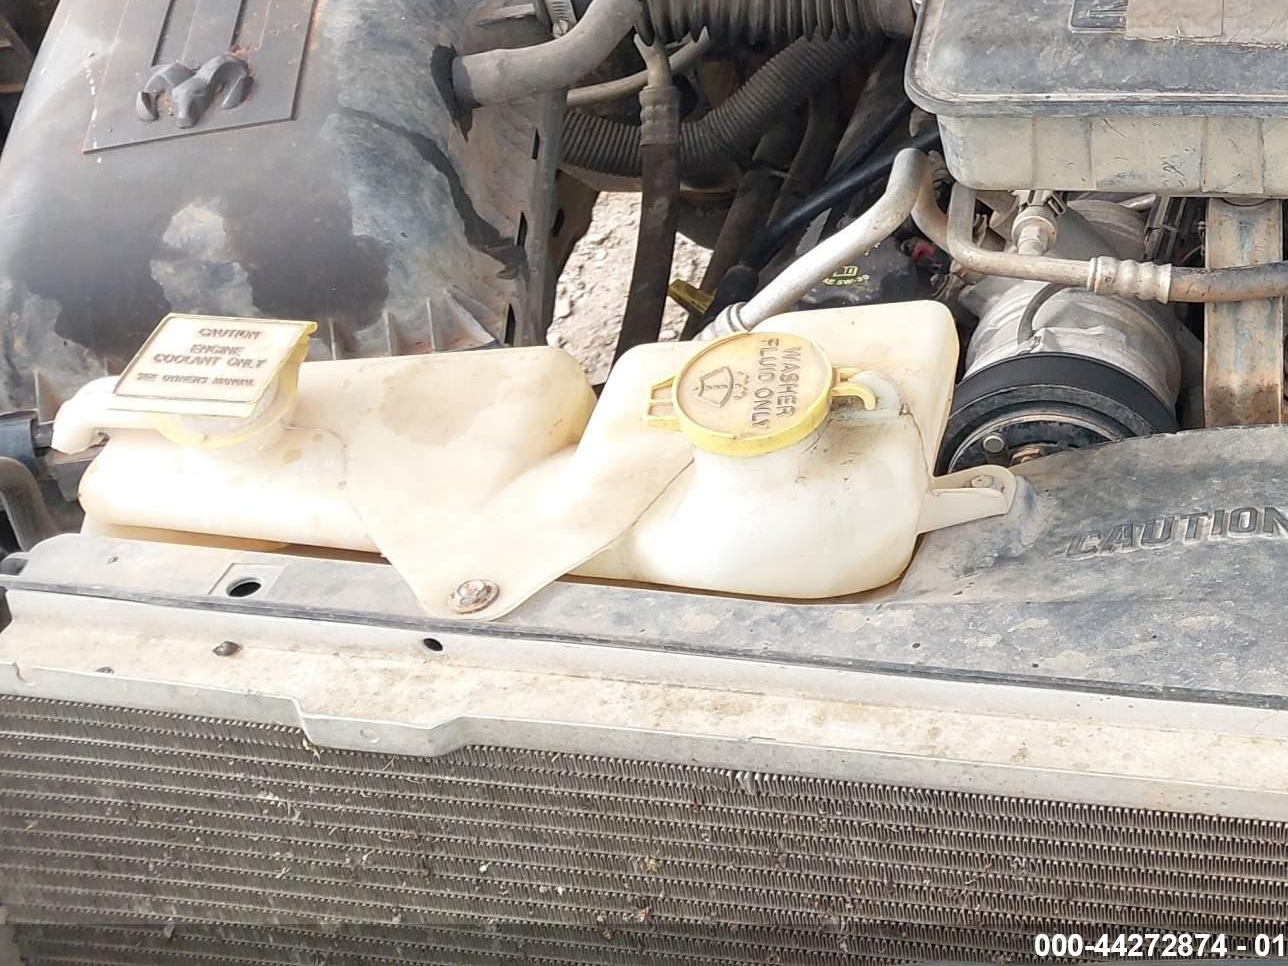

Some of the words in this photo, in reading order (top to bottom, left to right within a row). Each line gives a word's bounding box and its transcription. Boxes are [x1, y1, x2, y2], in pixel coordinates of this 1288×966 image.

[198, 328, 262, 339] CAUTION
[153, 353, 221, 366] COOLANT
[226, 357, 267, 369] ONLY
[189, 343, 244, 355] ENGINE
[758, 337, 780, 383] FLUID
[775, 346, 803, 418] WASHER
[751, 387, 774, 430] ONLY
